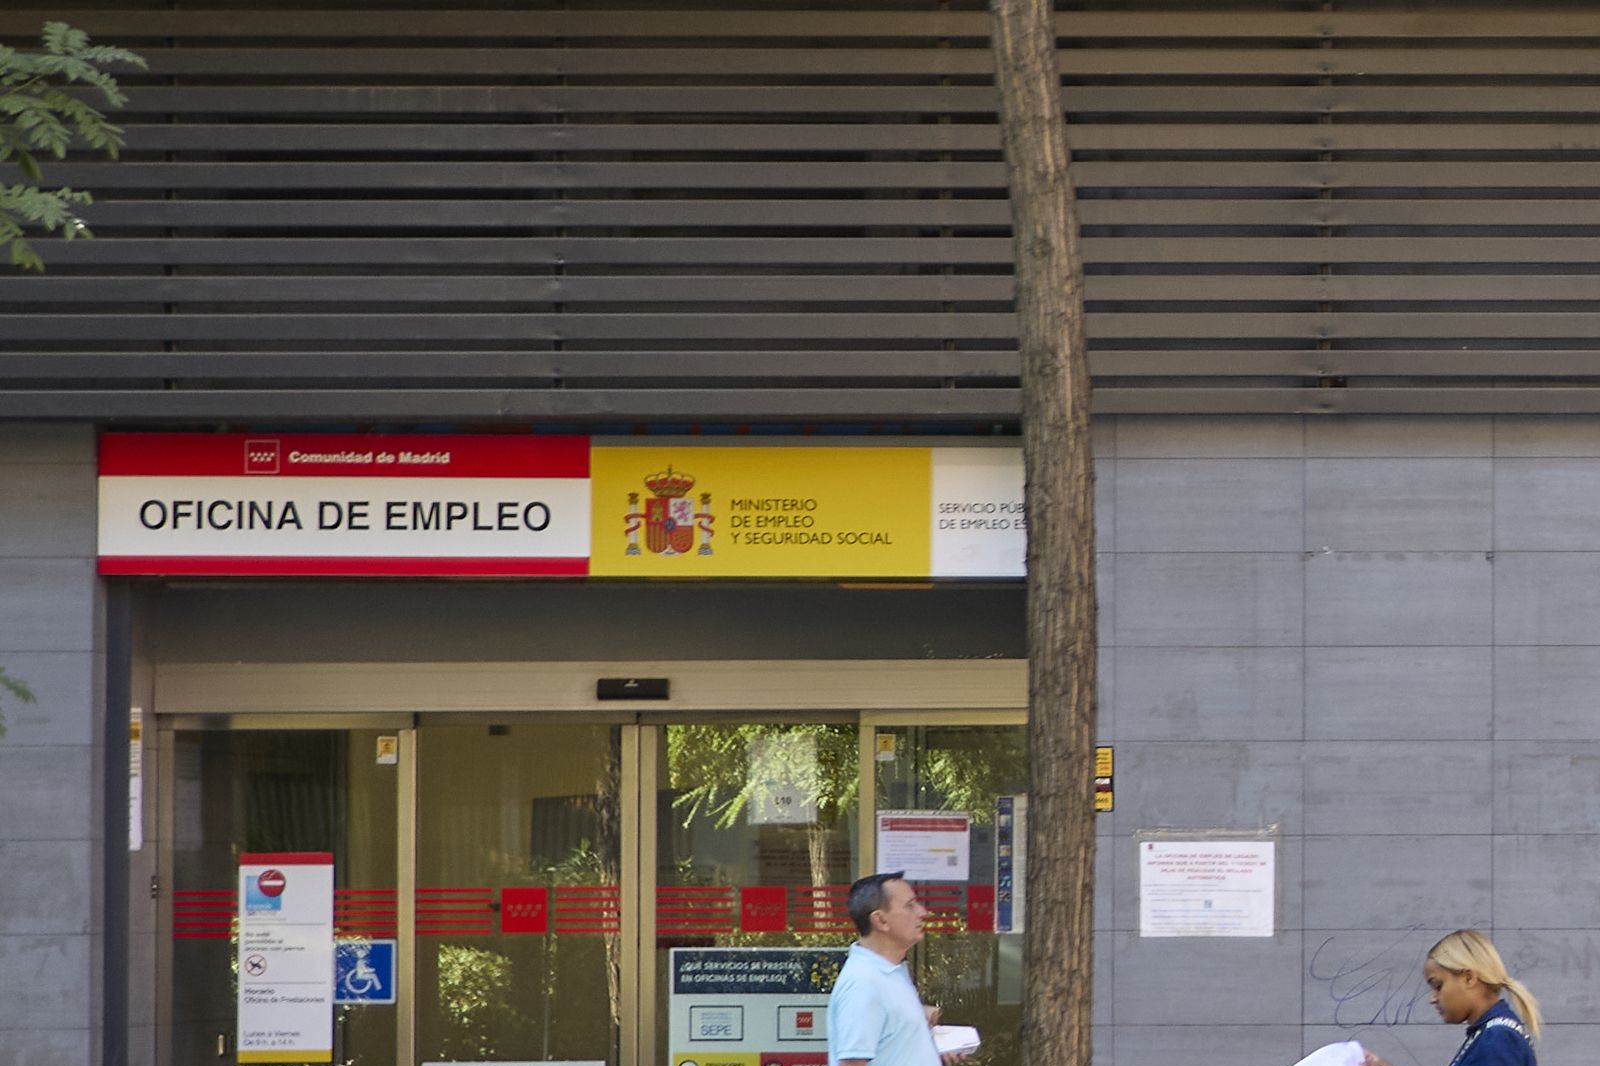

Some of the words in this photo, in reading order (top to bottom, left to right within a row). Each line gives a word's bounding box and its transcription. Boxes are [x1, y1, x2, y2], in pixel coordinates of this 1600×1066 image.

[288, 450, 373, 464] Comunidad
[376, 451, 396, 464] de
[398, 451, 450, 464] Madrid
[730, 498, 818, 512] MINISTERIO
[939, 502, 996, 514] SERVICIO
[139, 499, 302, 531] OFICINA
[318, 501, 370, 531] DE
[385, 501, 552, 532] EMPLEO
[730, 515, 753, 529] DE
[755, 515, 815, 529] EMPLEO
[939, 519, 957, 530] DE
[960, 519, 1010, 530] EMPLEO
[730, 532, 741, 545] Y
[744, 532, 833, 545] SEGURIDAD
[836, 532, 893, 545] SOCIAL
[700, 1024, 732, 1036] SEPE
